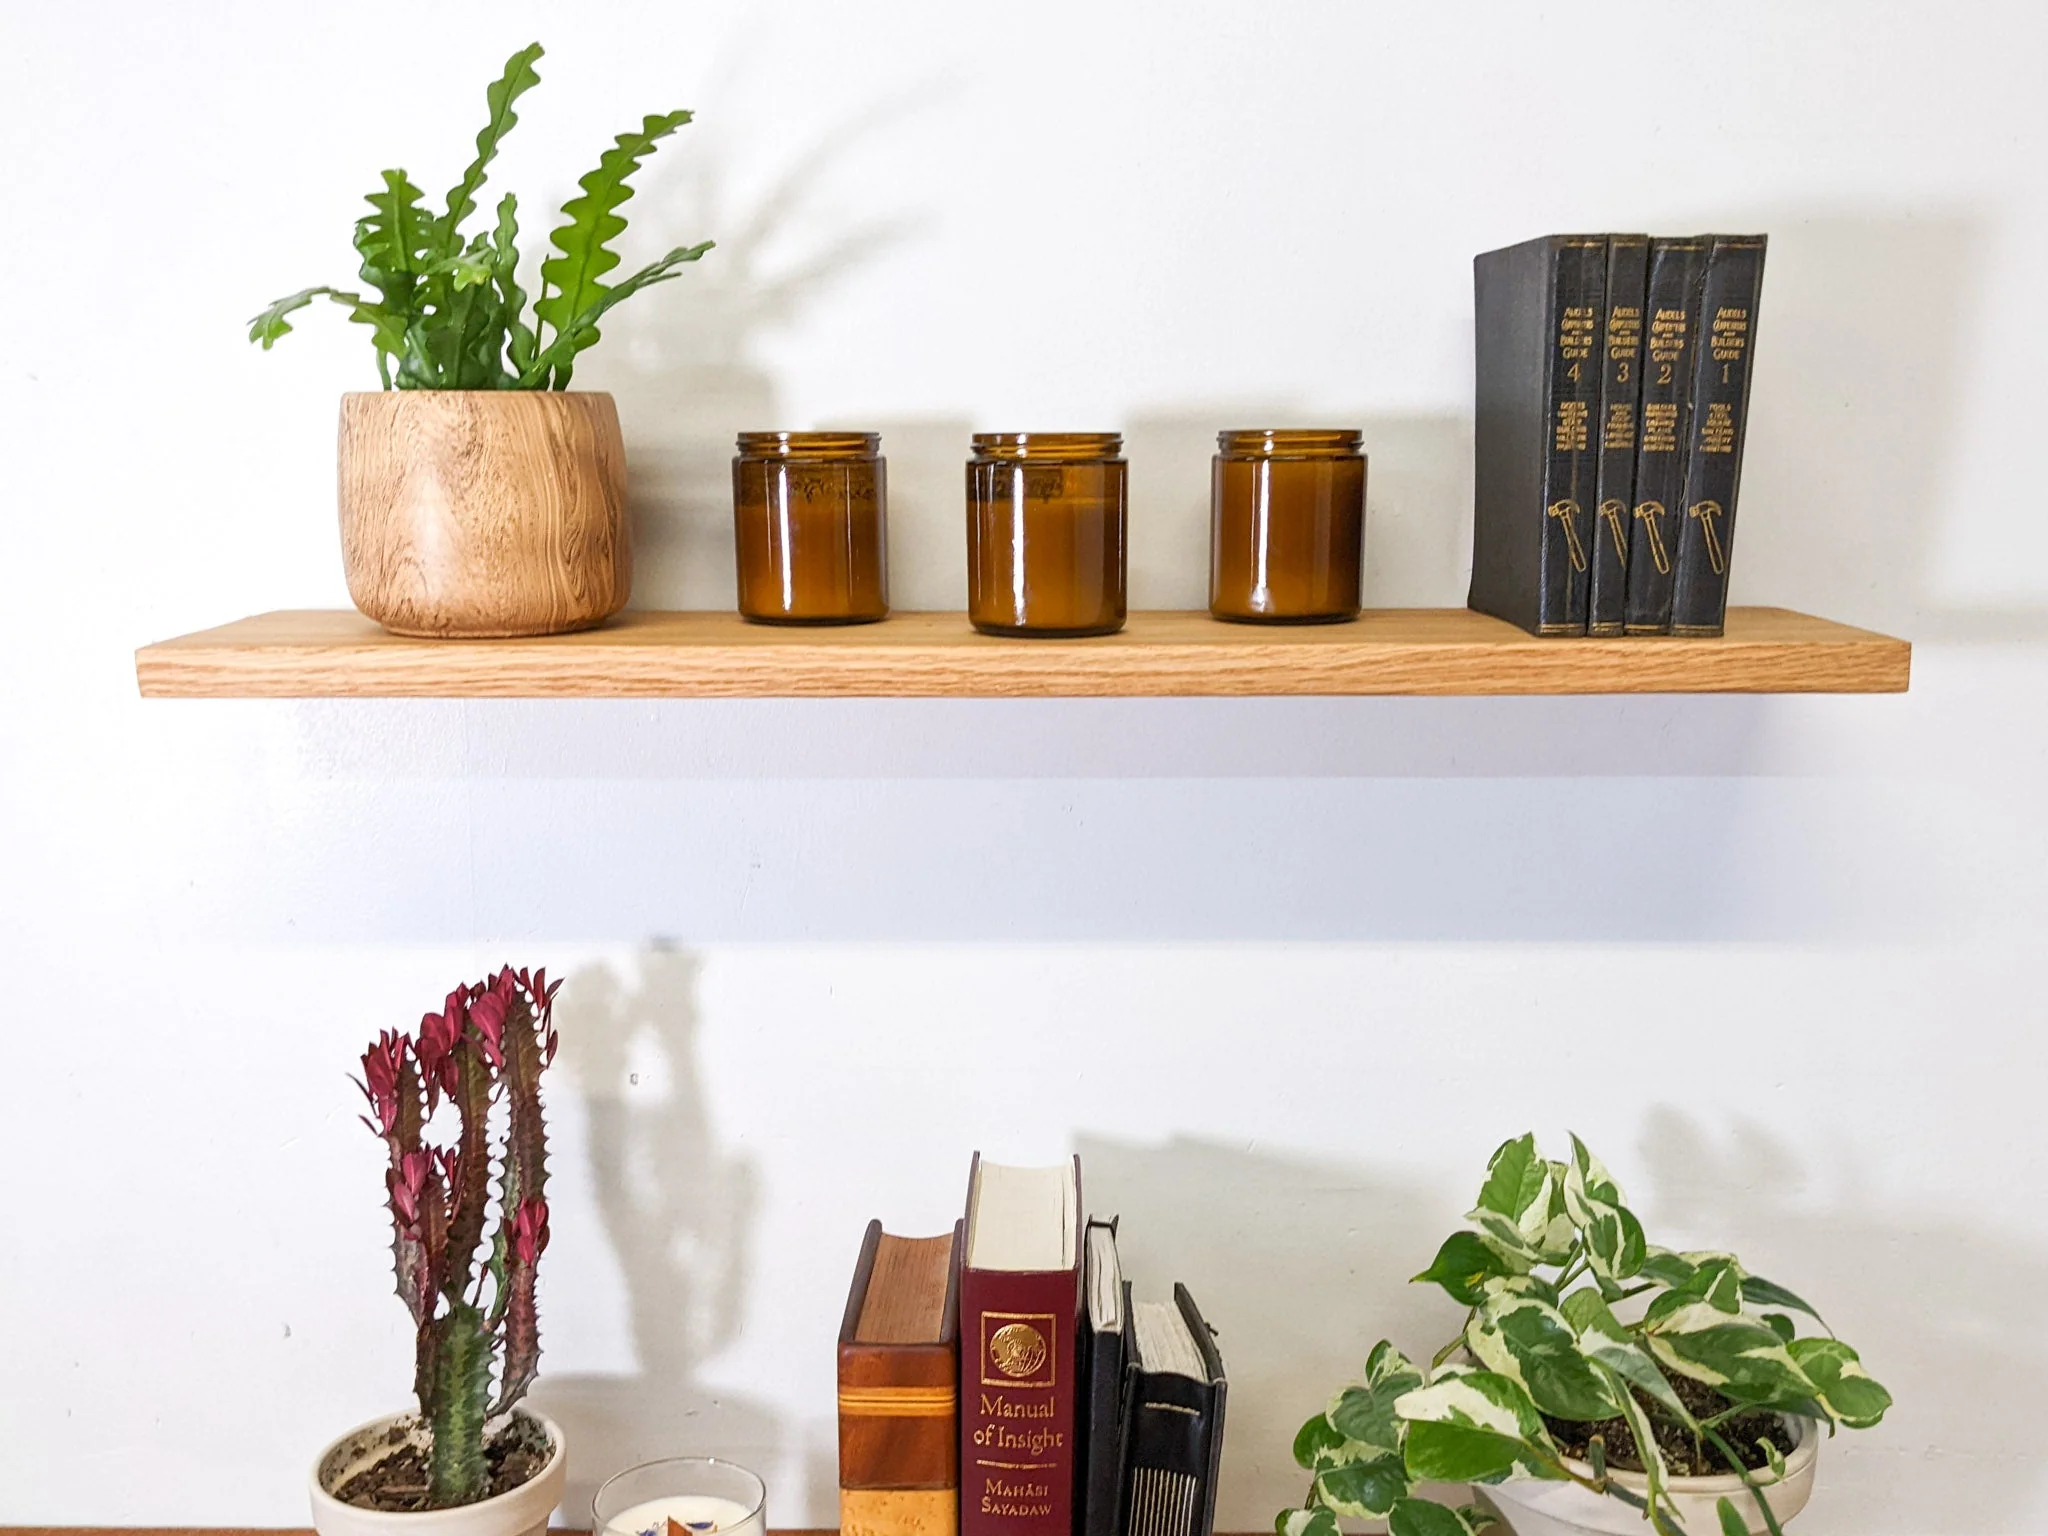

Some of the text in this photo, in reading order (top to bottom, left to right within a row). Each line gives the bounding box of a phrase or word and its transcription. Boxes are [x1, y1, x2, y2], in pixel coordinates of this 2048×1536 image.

[1611, 347, 1636, 360] GUIDE
[1652, 350, 1679, 362] GUIDE
[1713, 349, 1740, 360] GUIDE
[1567, 363, 1581, 382] 4
[1617, 362, 1630, 383] 3
[1657, 364, 1672, 385] 2
[1722, 363, 1730, 384] 1
[980, 1393, 1056, 1418] Manual
[973, 1424, 1064, 1456] of Insight
[981, 1496, 1052, 1516] SAYADAW
